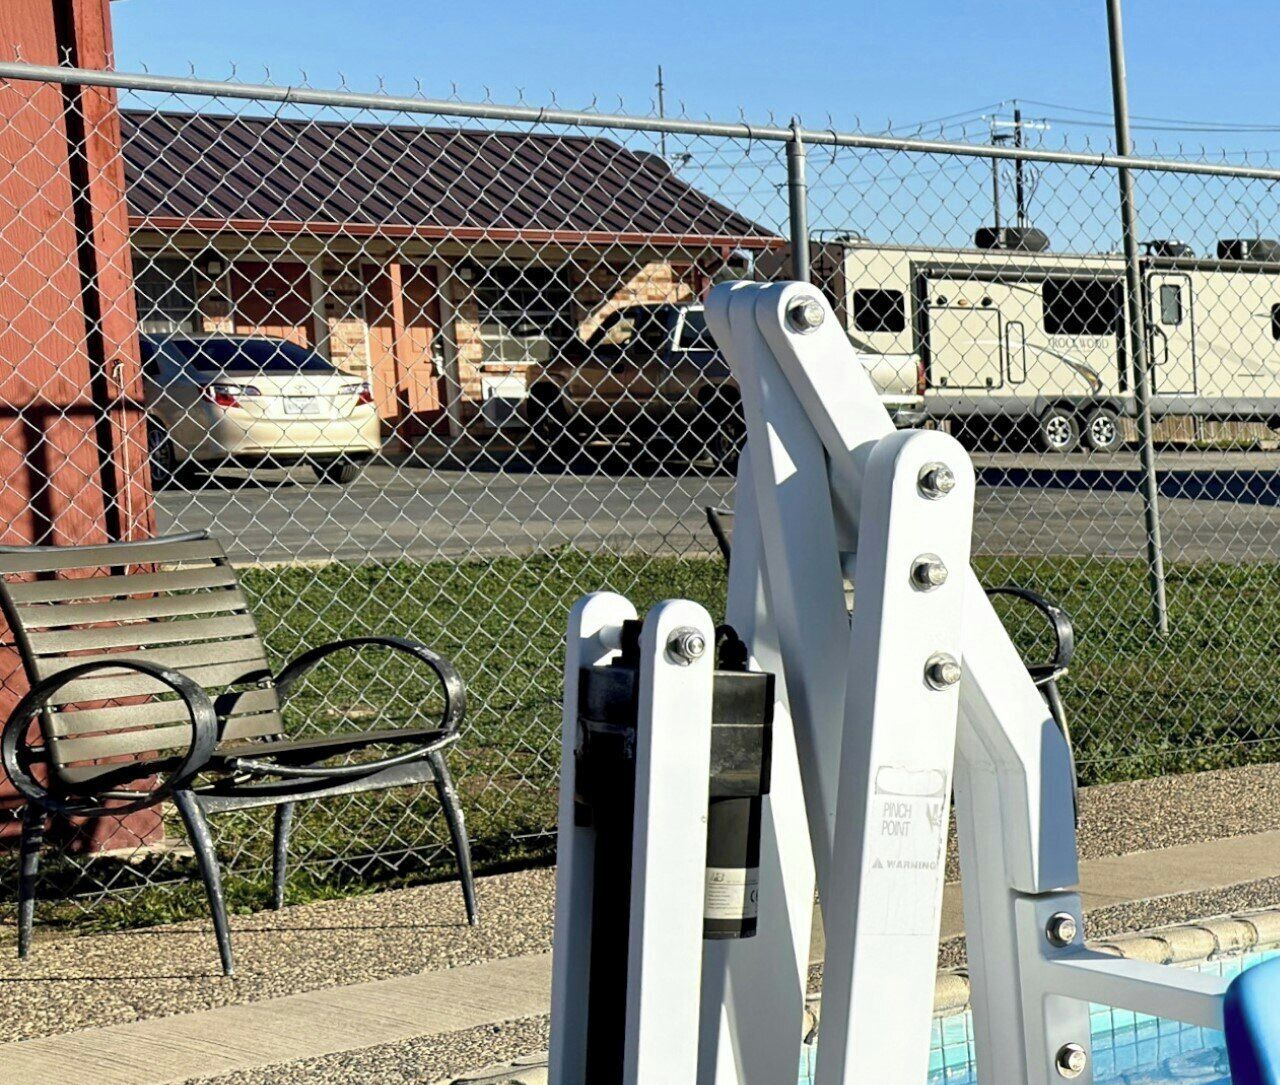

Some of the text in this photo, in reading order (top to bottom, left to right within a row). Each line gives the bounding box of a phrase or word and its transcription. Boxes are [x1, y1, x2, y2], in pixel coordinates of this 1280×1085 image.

[1052, 337, 1109, 349] ROCWOOD
[882, 802, 912, 818] PINCH
[881, 820, 911, 836] POINT
[886, 860, 937, 870] WARNING
